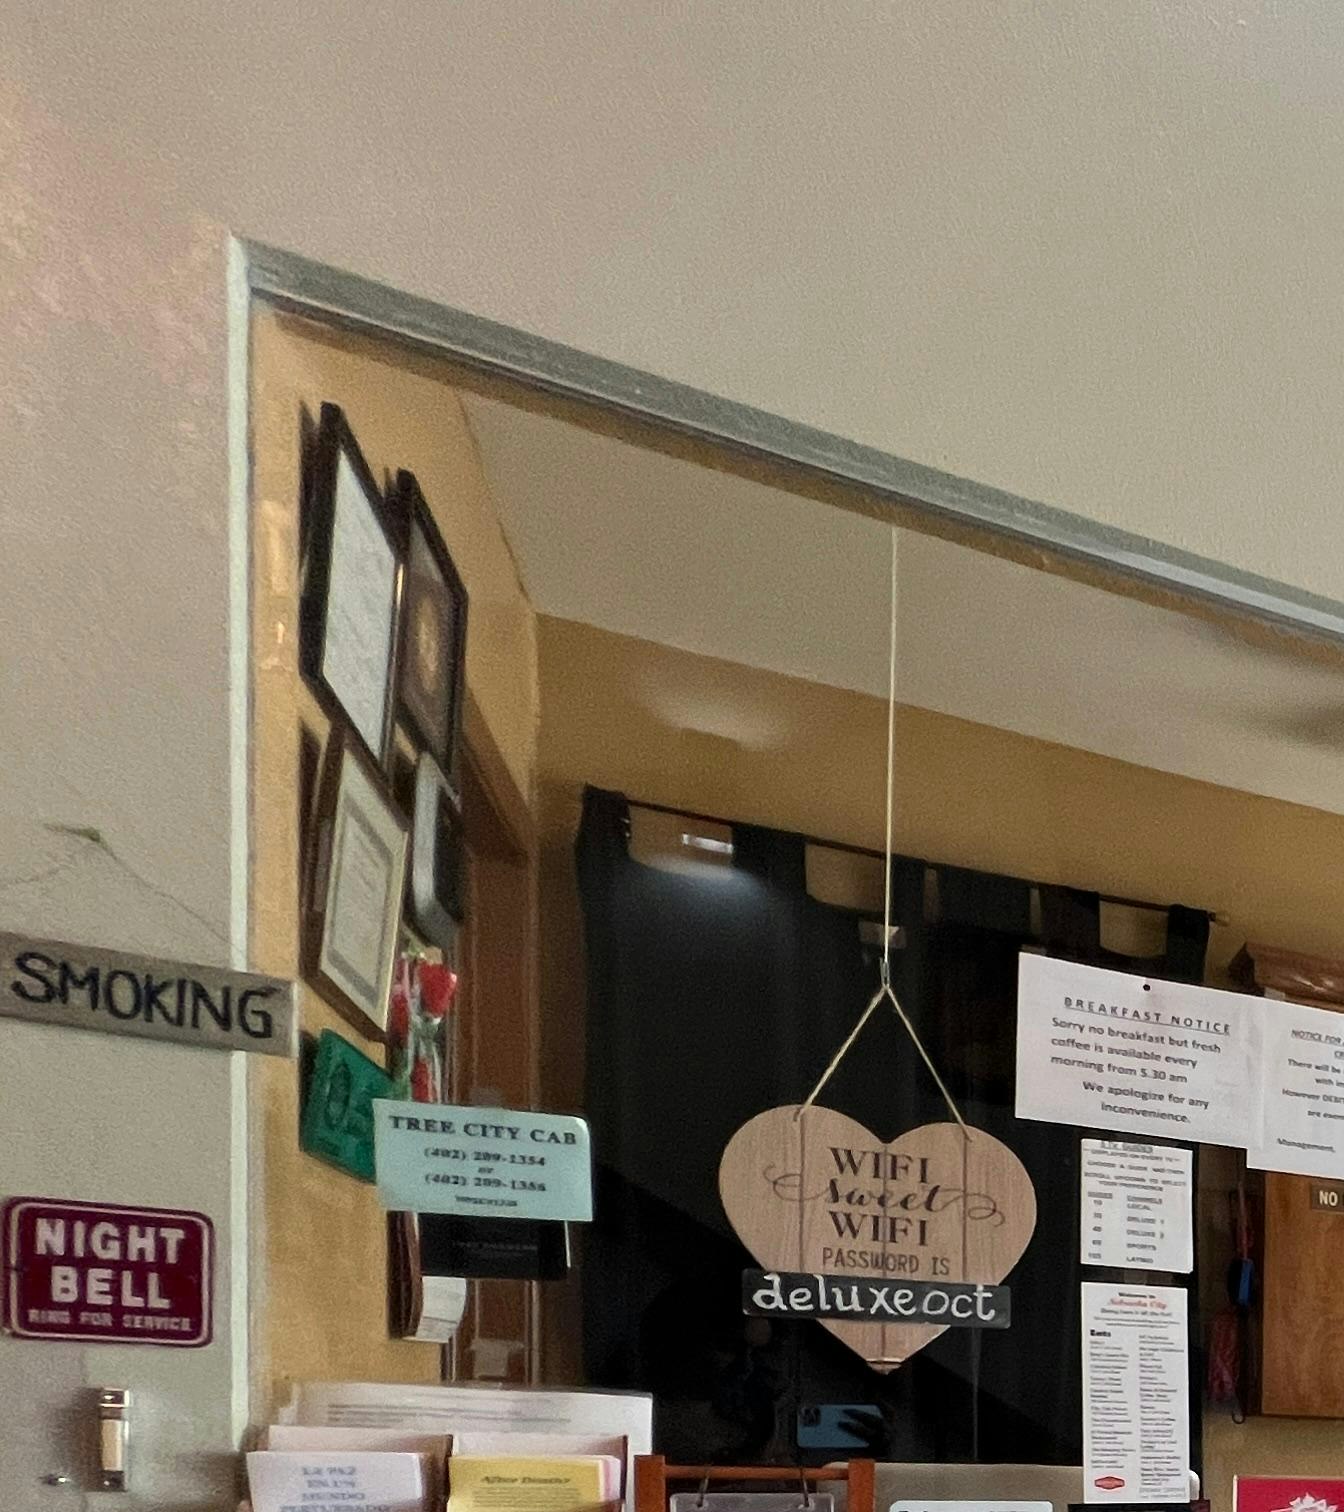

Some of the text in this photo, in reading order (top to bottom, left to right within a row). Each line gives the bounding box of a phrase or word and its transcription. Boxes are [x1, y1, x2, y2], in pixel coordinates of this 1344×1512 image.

[11, 952, 279, 1038] SMOKING
[1064, 997, 1231, 1034] BREAKFAST NOTICE
[1052, 1018, 1221, 1053] Sorry no breakfast but fresh
[1292, 1030, 1322, 1042] NOTICE
[1325, 1035, 1341, 1045] FOR
[1052, 1037, 1197, 1069] coffee is available every
[1288, 1059, 1312, 1069] There
[1051, 1055, 1104, 1072] morning
[1108, 1064, 1137, 1075] from
[1169, 1074, 1187, 1083] am
[1315, 1078, 1334, 1086] with
[1083, 1081, 1209, 1110] We apologize for any
[390, 1116, 577, 1145] TREE CITY CAB
[829, 1147, 931, 1183] WIFI
[1319, 1191, 1337, 1206] NO
[36, 1218, 185, 1264] NIGHT
[829, 1211, 928, 1246] WIFI
[823, 1247, 950, 1276] PASSWORD IS
[52, 1266, 170, 1309] BELL
[80, 1312, 112, 1326] FOR
[123, 1314, 192, 1331] SERVICE
